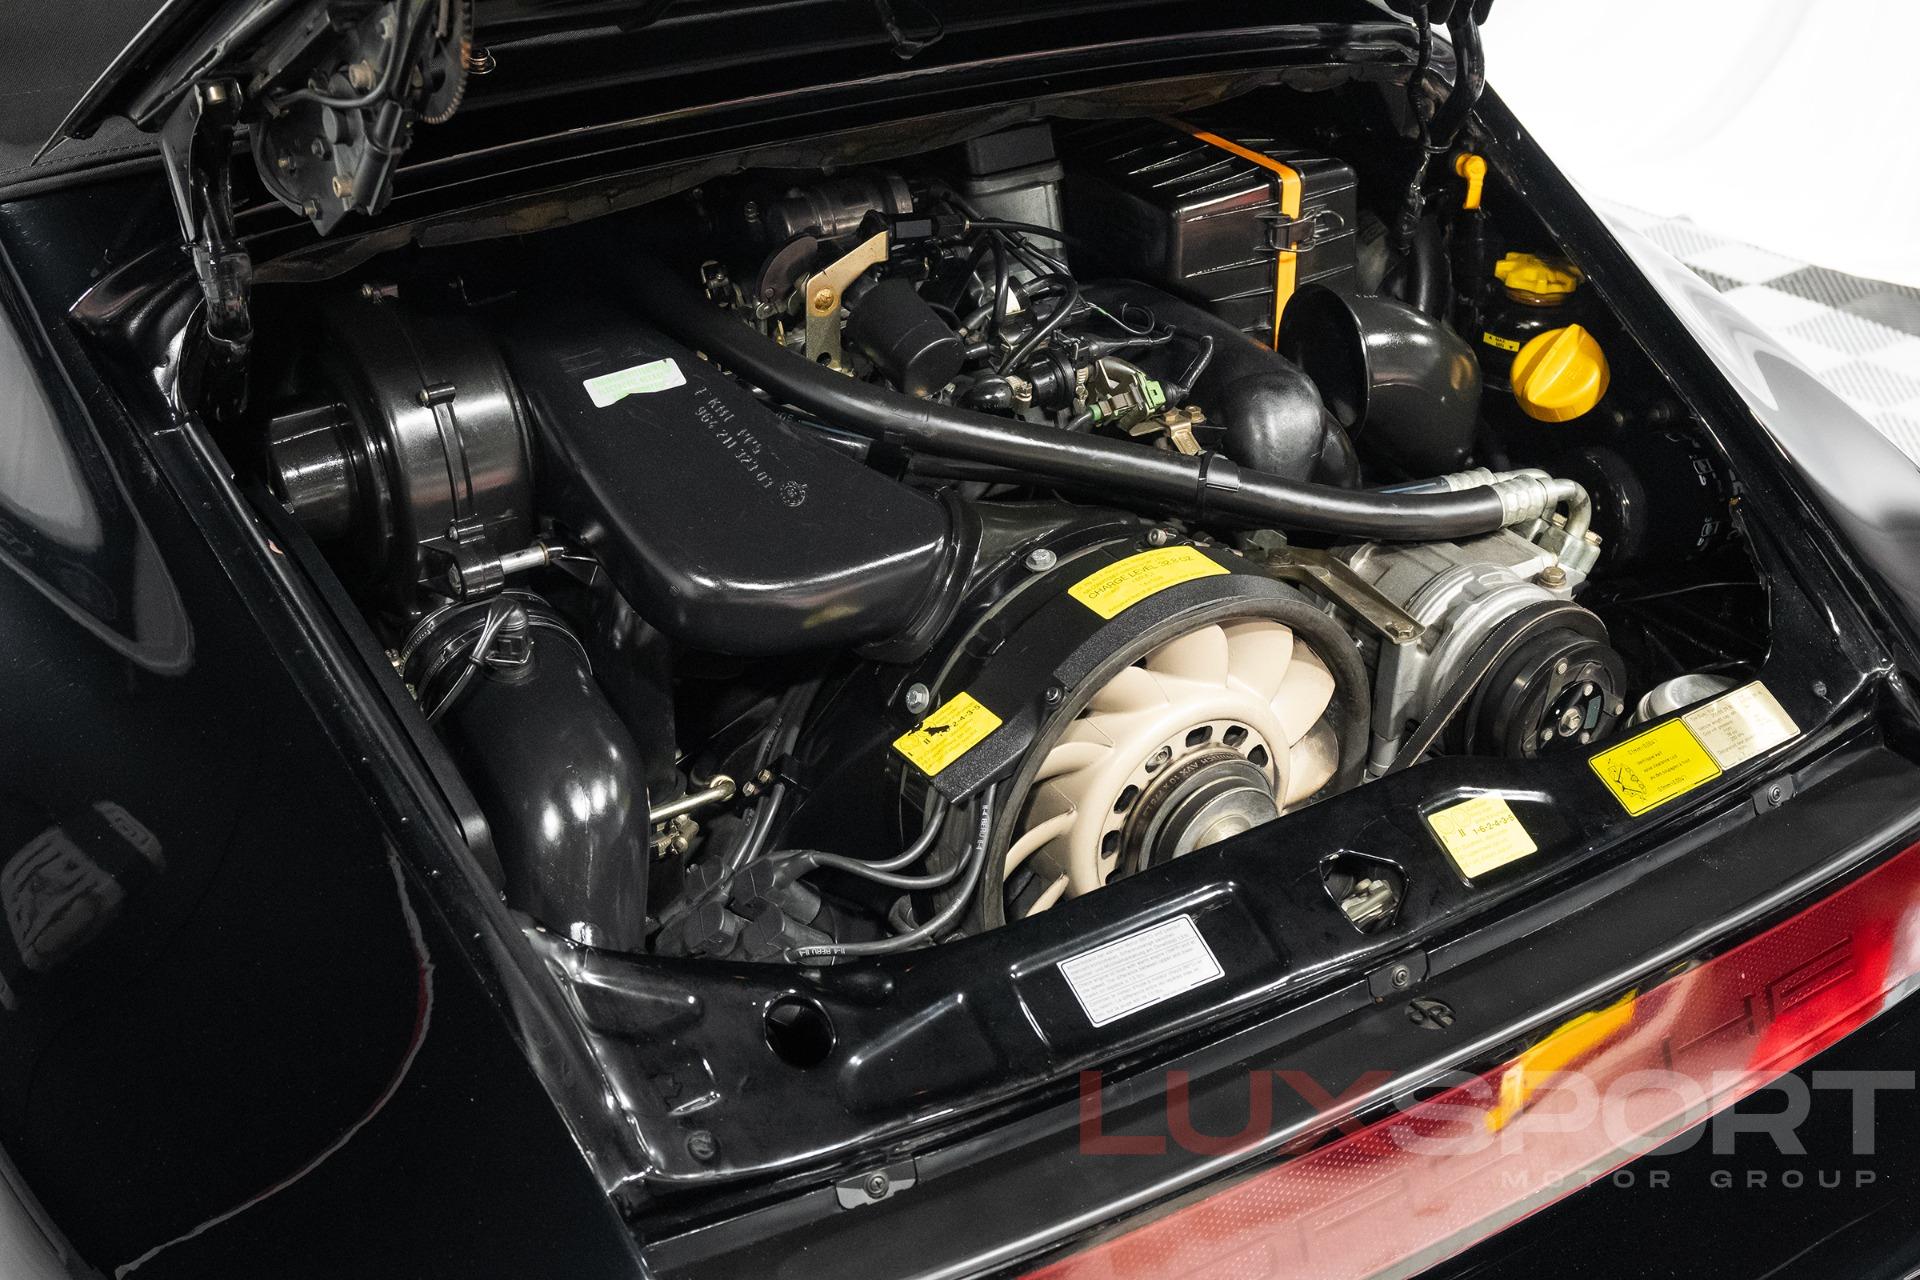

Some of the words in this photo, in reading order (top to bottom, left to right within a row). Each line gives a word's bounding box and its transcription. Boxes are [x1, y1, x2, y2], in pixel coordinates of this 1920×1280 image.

[1088, 573, 1129, 599] CHARGE
[1129, 564, 1159, 578] LEVEL
[1472, 815, 1514, 834] 1-6-2-4-3-5
